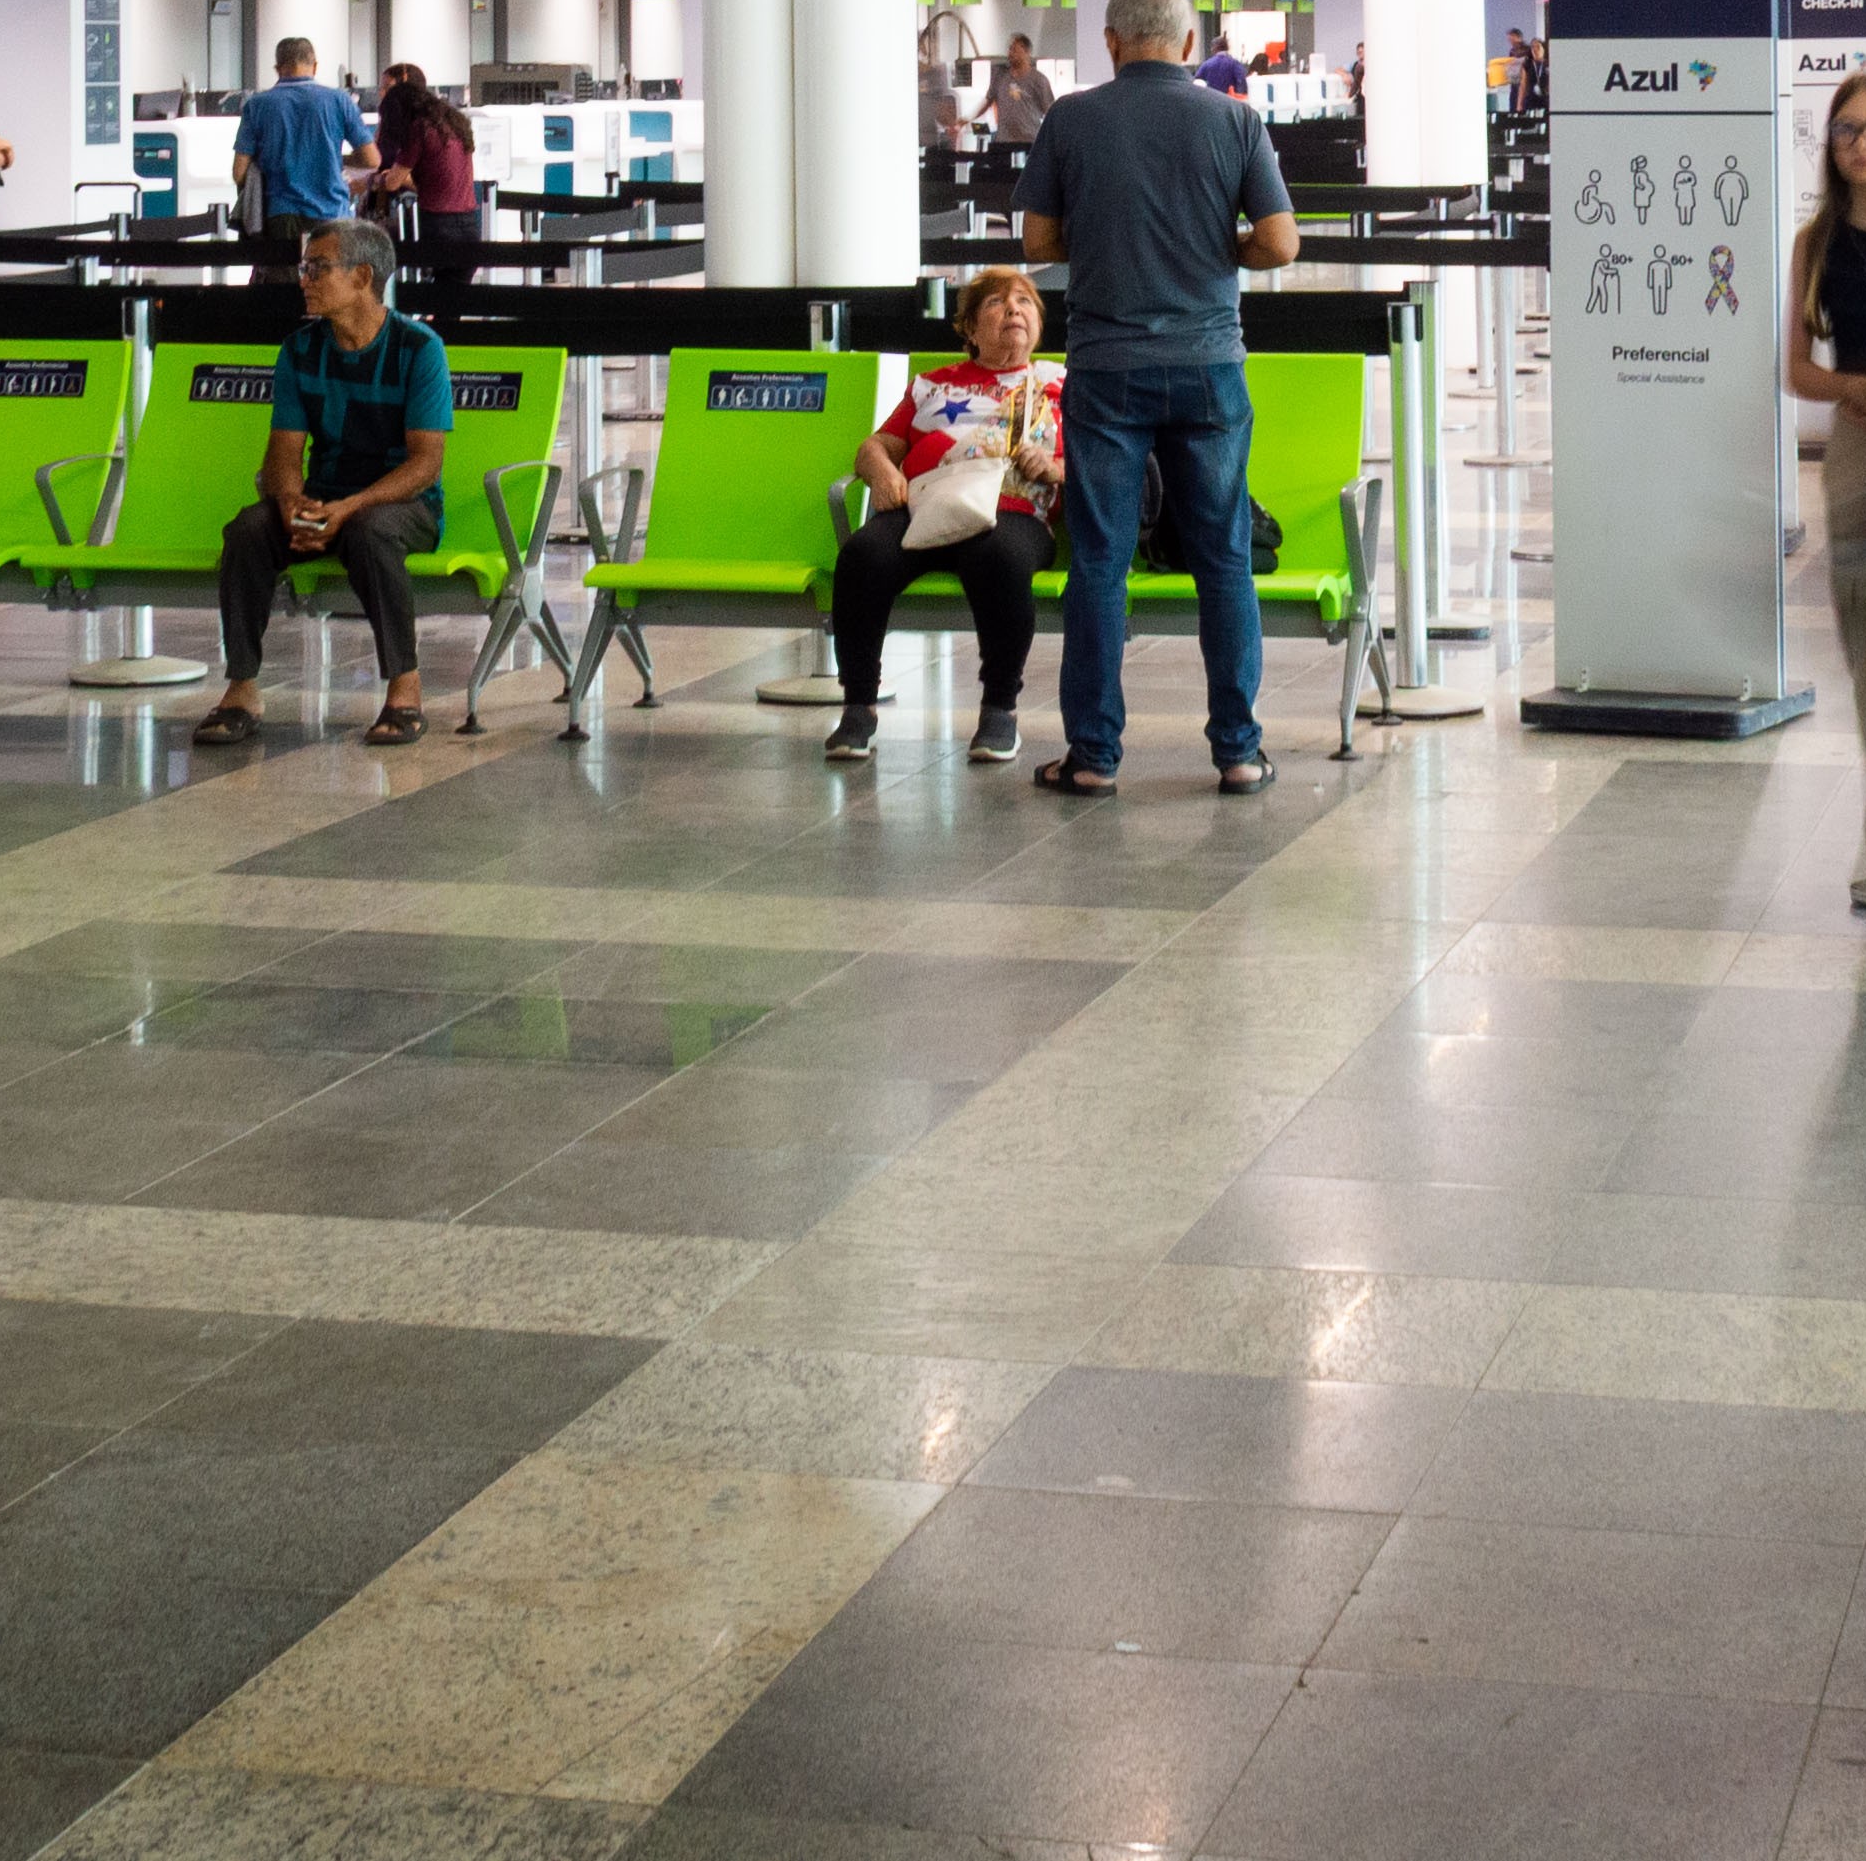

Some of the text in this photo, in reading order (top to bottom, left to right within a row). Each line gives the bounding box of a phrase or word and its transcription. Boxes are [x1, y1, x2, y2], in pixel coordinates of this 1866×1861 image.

[1799, 53, 1846, 71] Azul
[1604, 62, 1678, 92] Azul
[1671, 255, 1693, 266] 60+
[1612, 345, 1710, 362] Preferencial
[731, 373, 805, 383] Assentos Preferenciais
[1616, 372, 1705, 384] Special Assistance
